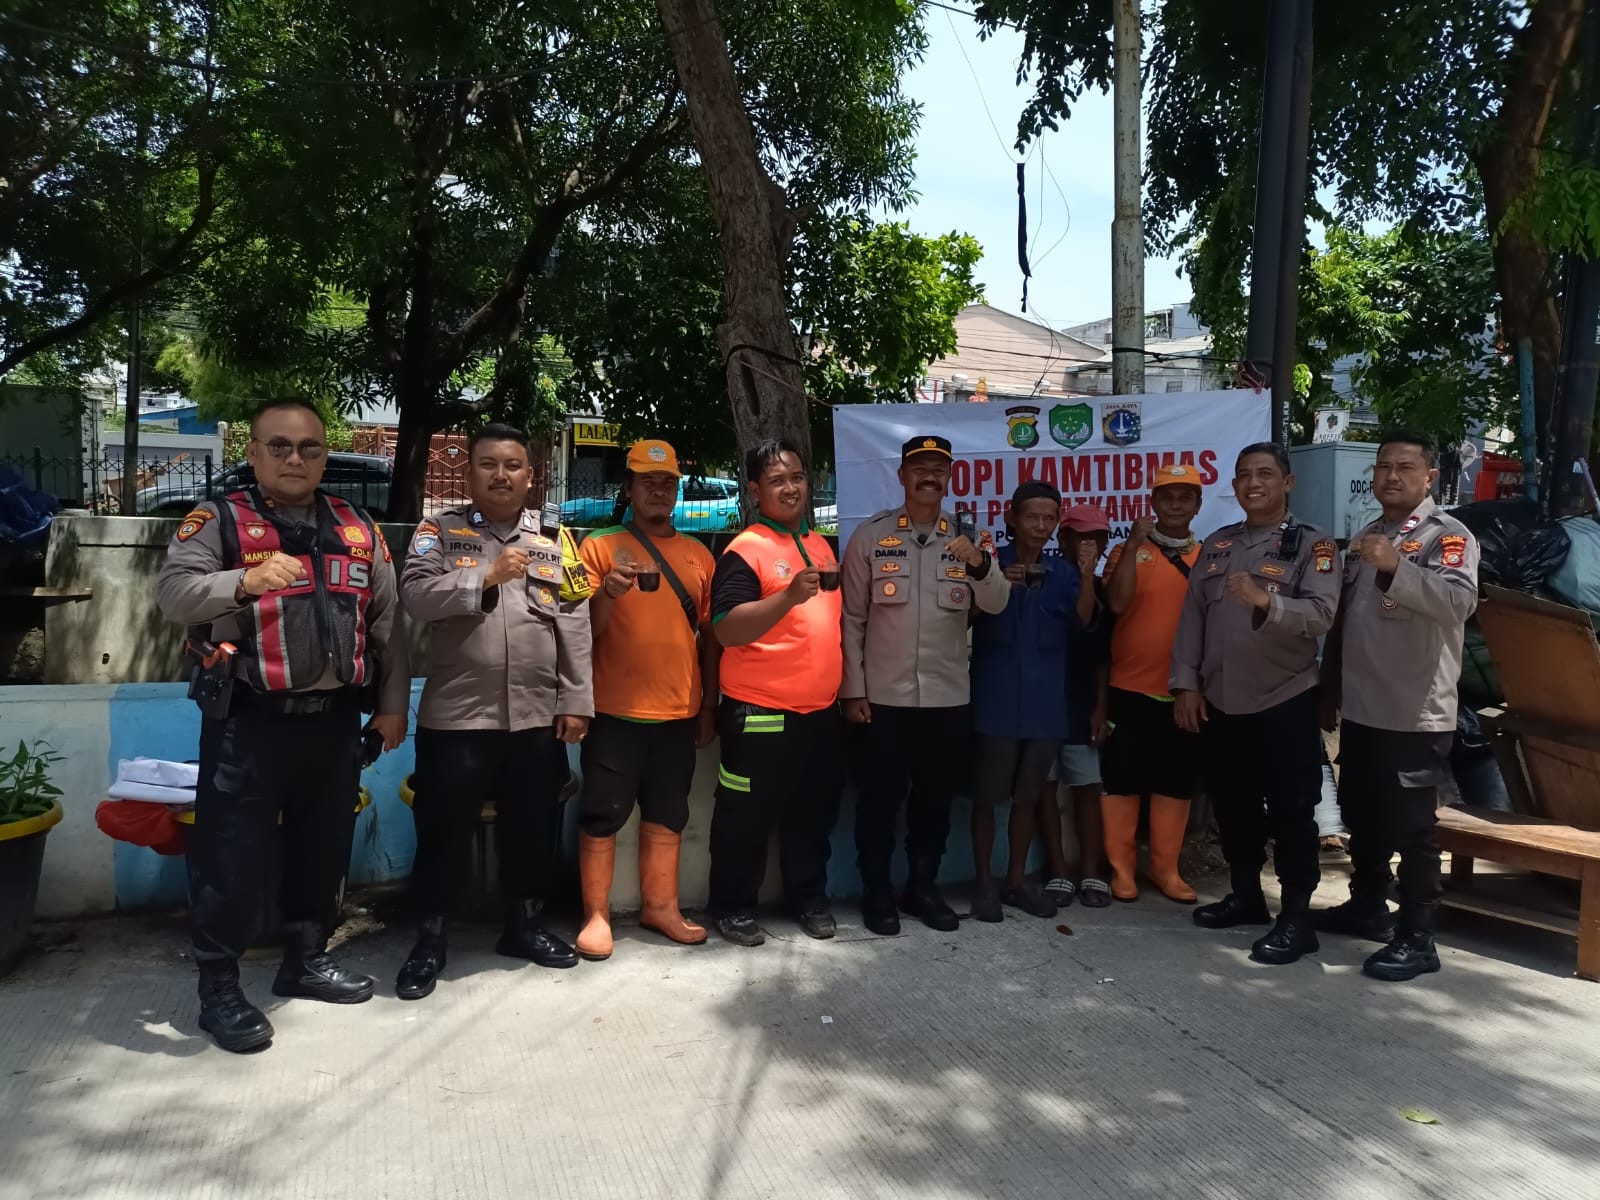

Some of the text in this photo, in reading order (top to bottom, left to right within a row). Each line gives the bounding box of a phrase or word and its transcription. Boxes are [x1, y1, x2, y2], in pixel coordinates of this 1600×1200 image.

[945, 458, 1004, 497] OPI
[450, 541, 482, 553] IRON
[528, 550, 561, 564] POLRI
[941, 553, 964, 563] POL
